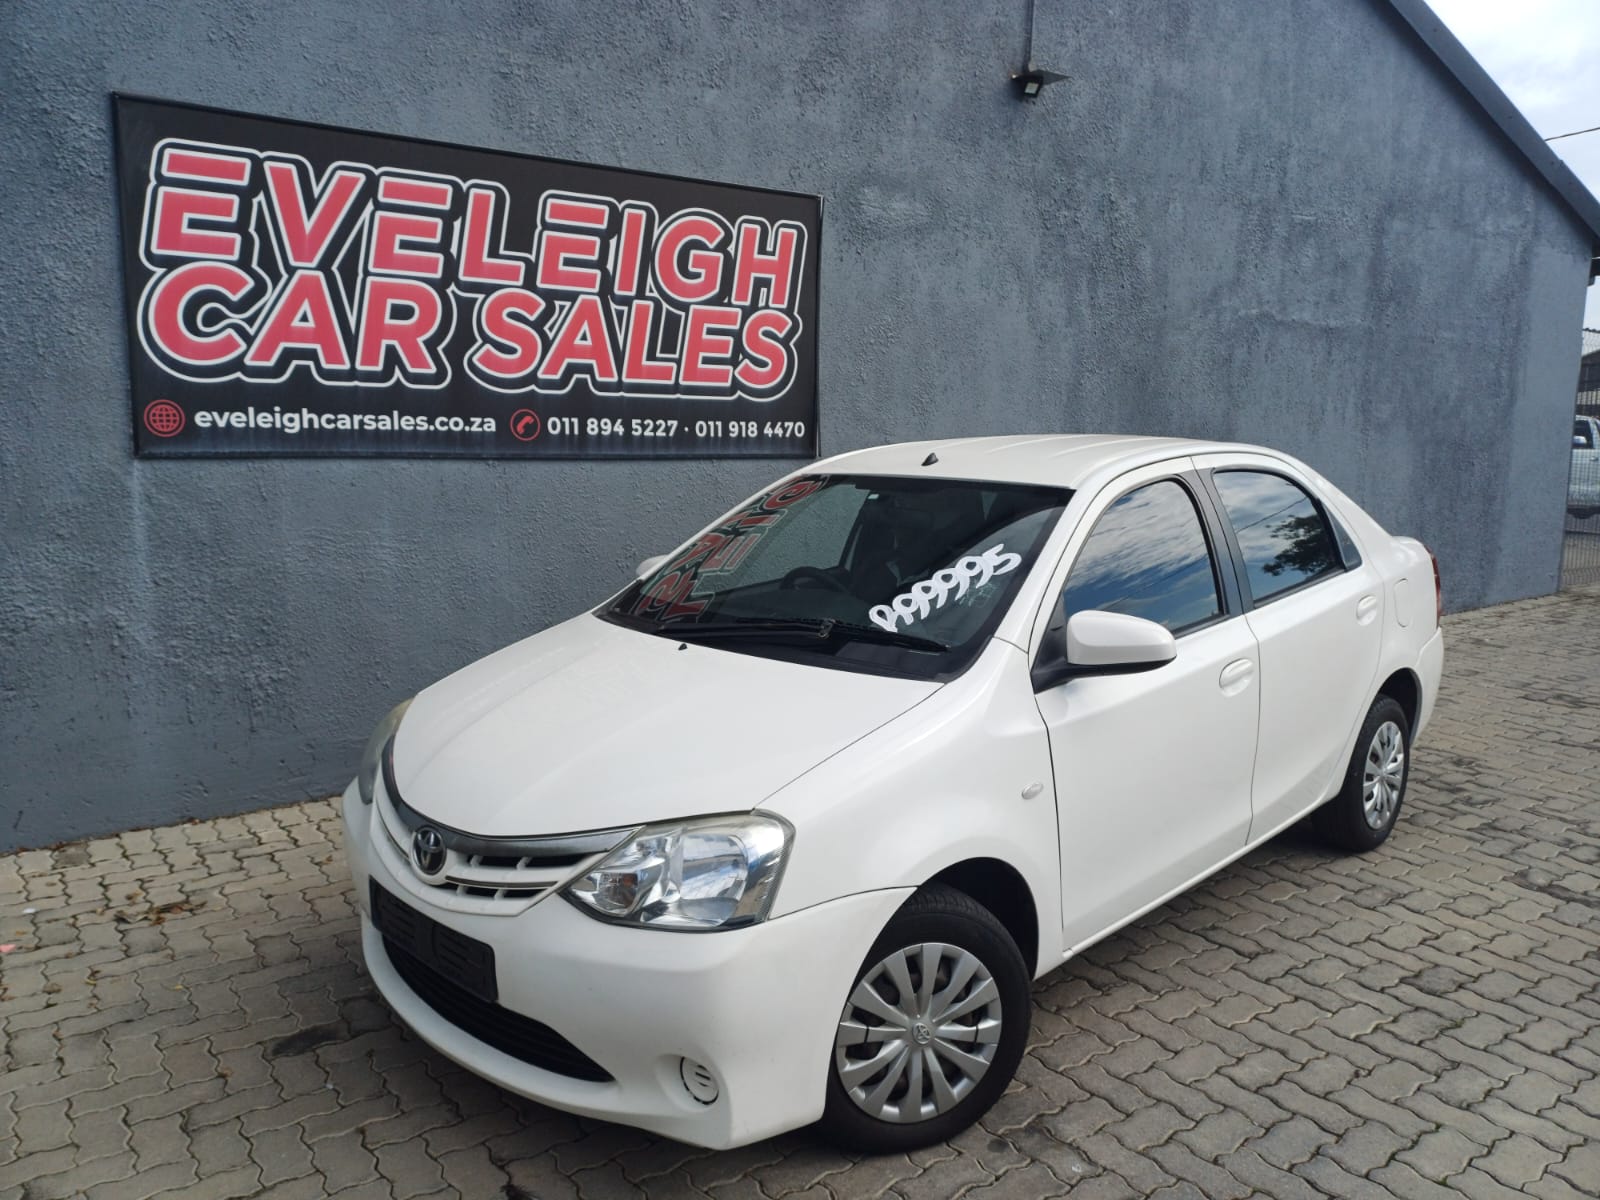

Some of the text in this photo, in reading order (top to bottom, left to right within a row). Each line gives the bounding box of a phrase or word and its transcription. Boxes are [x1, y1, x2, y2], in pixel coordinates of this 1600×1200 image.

[152, 151, 796, 306] EVELEIGH
[152, 264, 790, 386] CAR SALES
[194, 405, 497, 434] eveleighcarsales.co.za
[547, 416, 805, 438] 011 894 5227 011 918 4470
[868, 543, 1022, 633] R99995
